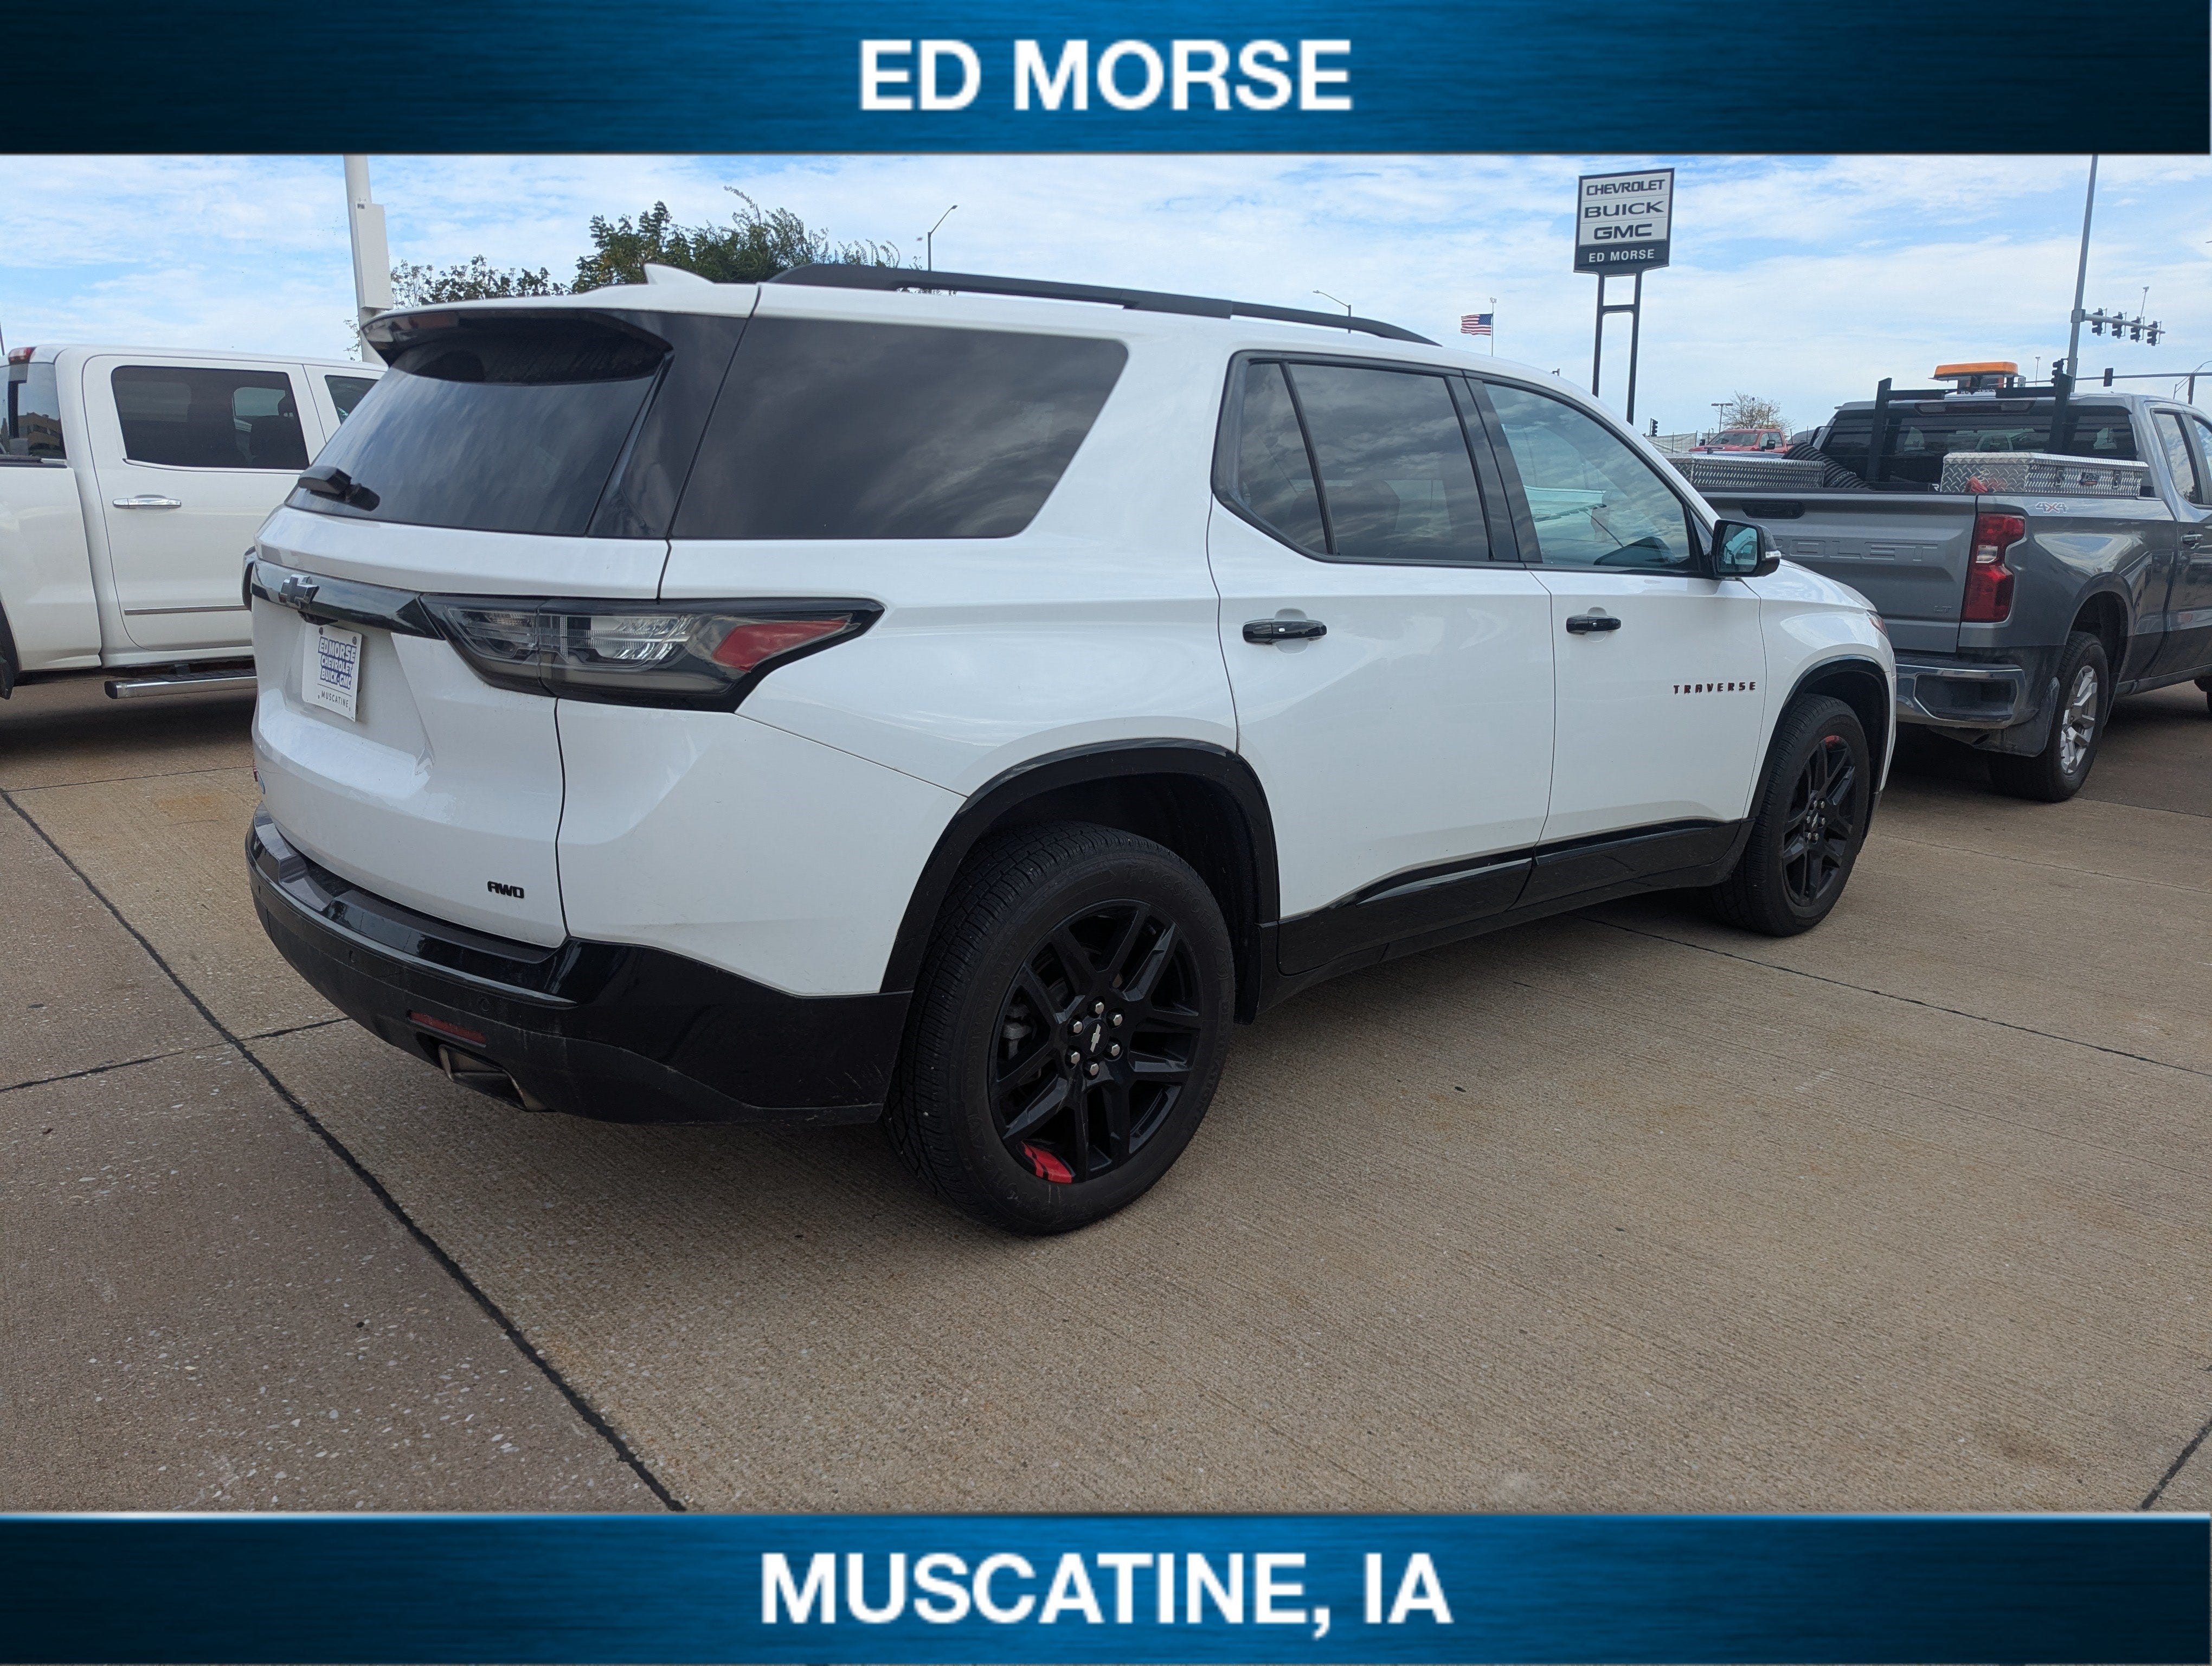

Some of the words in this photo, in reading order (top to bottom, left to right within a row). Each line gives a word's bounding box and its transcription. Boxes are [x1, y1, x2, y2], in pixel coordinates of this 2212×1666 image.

[1586, 180, 1665, 196] CHEVROLET
[1584, 201, 1664, 219] BUICK
[1594, 223, 1652, 240] GMC
[1589, 252, 1605, 262] ED
[1610, 249, 1655, 261] MORSE
[319, 637, 329, 653] ED
[329, 640, 357, 663] MORSE
[321, 655, 353, 675] CHEVROLET
[321, 669, 338, 683] BUICK
[339, 674, 352, 688] GMC
[1673, 682, 1756, 695] TRAVERSE
[321, 690, 349, 708] MUSCATINE
[487, 881, 524, 899] AWD
